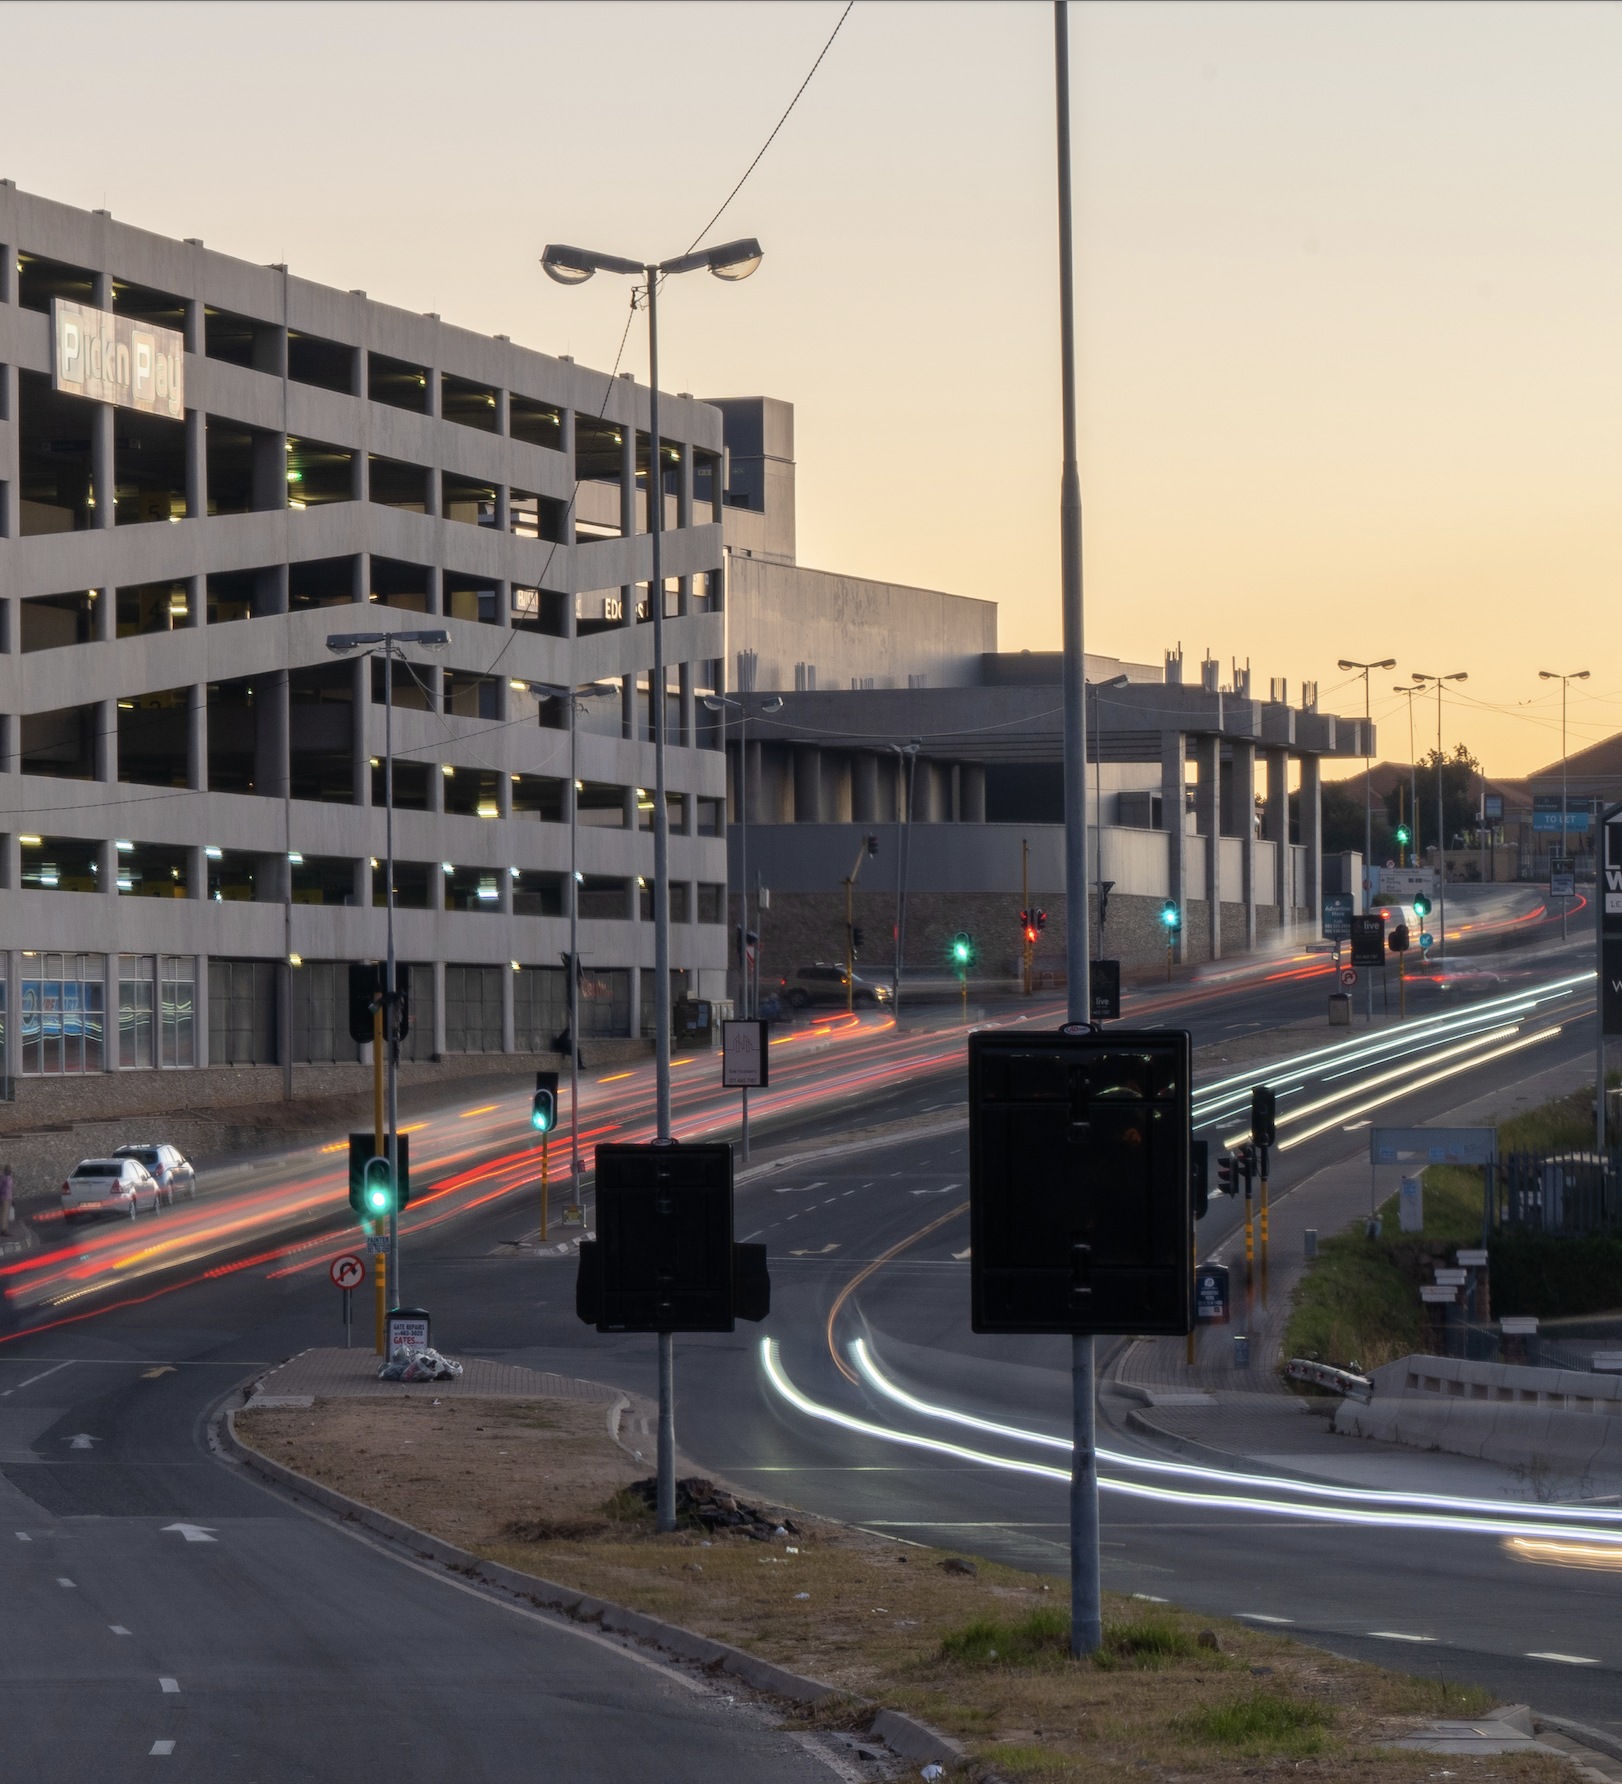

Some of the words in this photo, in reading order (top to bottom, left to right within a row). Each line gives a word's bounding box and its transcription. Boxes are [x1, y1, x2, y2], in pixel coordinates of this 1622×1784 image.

[1545, 815, 1557, 823] TO
[1363, 920, 1380, 930] live
[1095, 997, 1109, 1005] live
